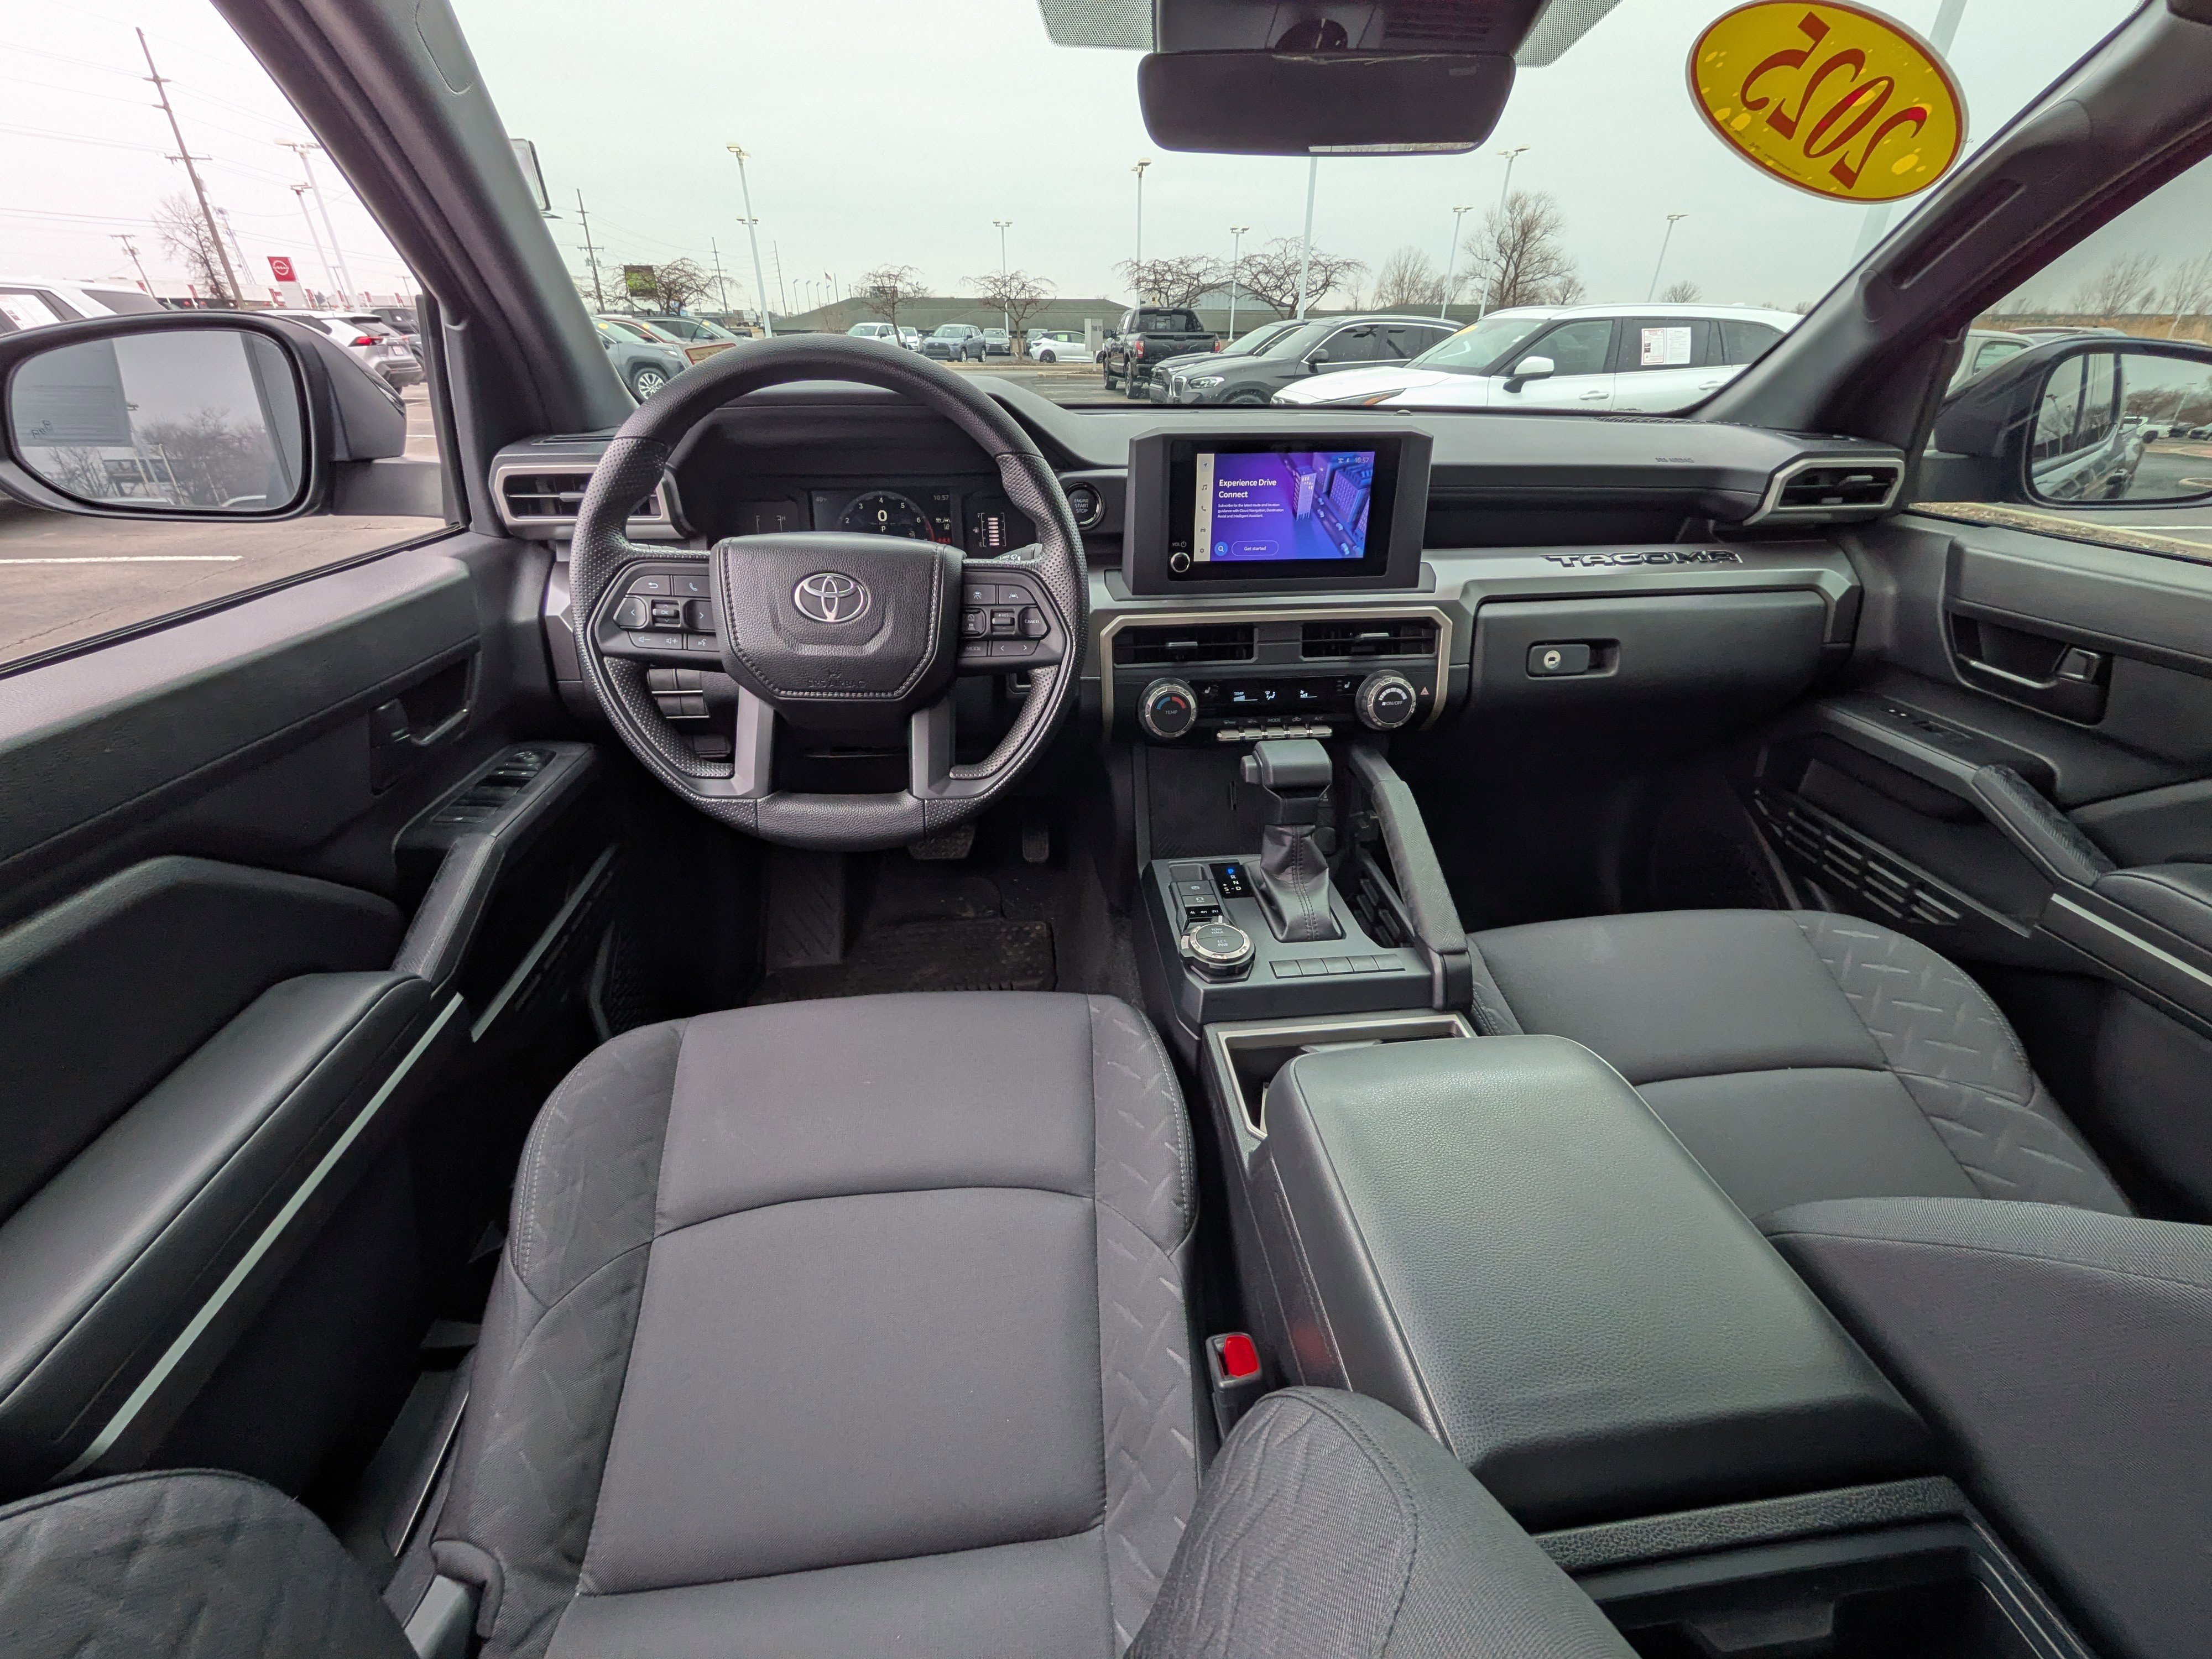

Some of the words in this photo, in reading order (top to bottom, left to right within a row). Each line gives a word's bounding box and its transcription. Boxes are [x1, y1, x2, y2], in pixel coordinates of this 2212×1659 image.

[1219, 479, 1258, 488] Experience
[877, 510, 888, 521] 0
[1540, 550, 1743, 567] TACOMA
